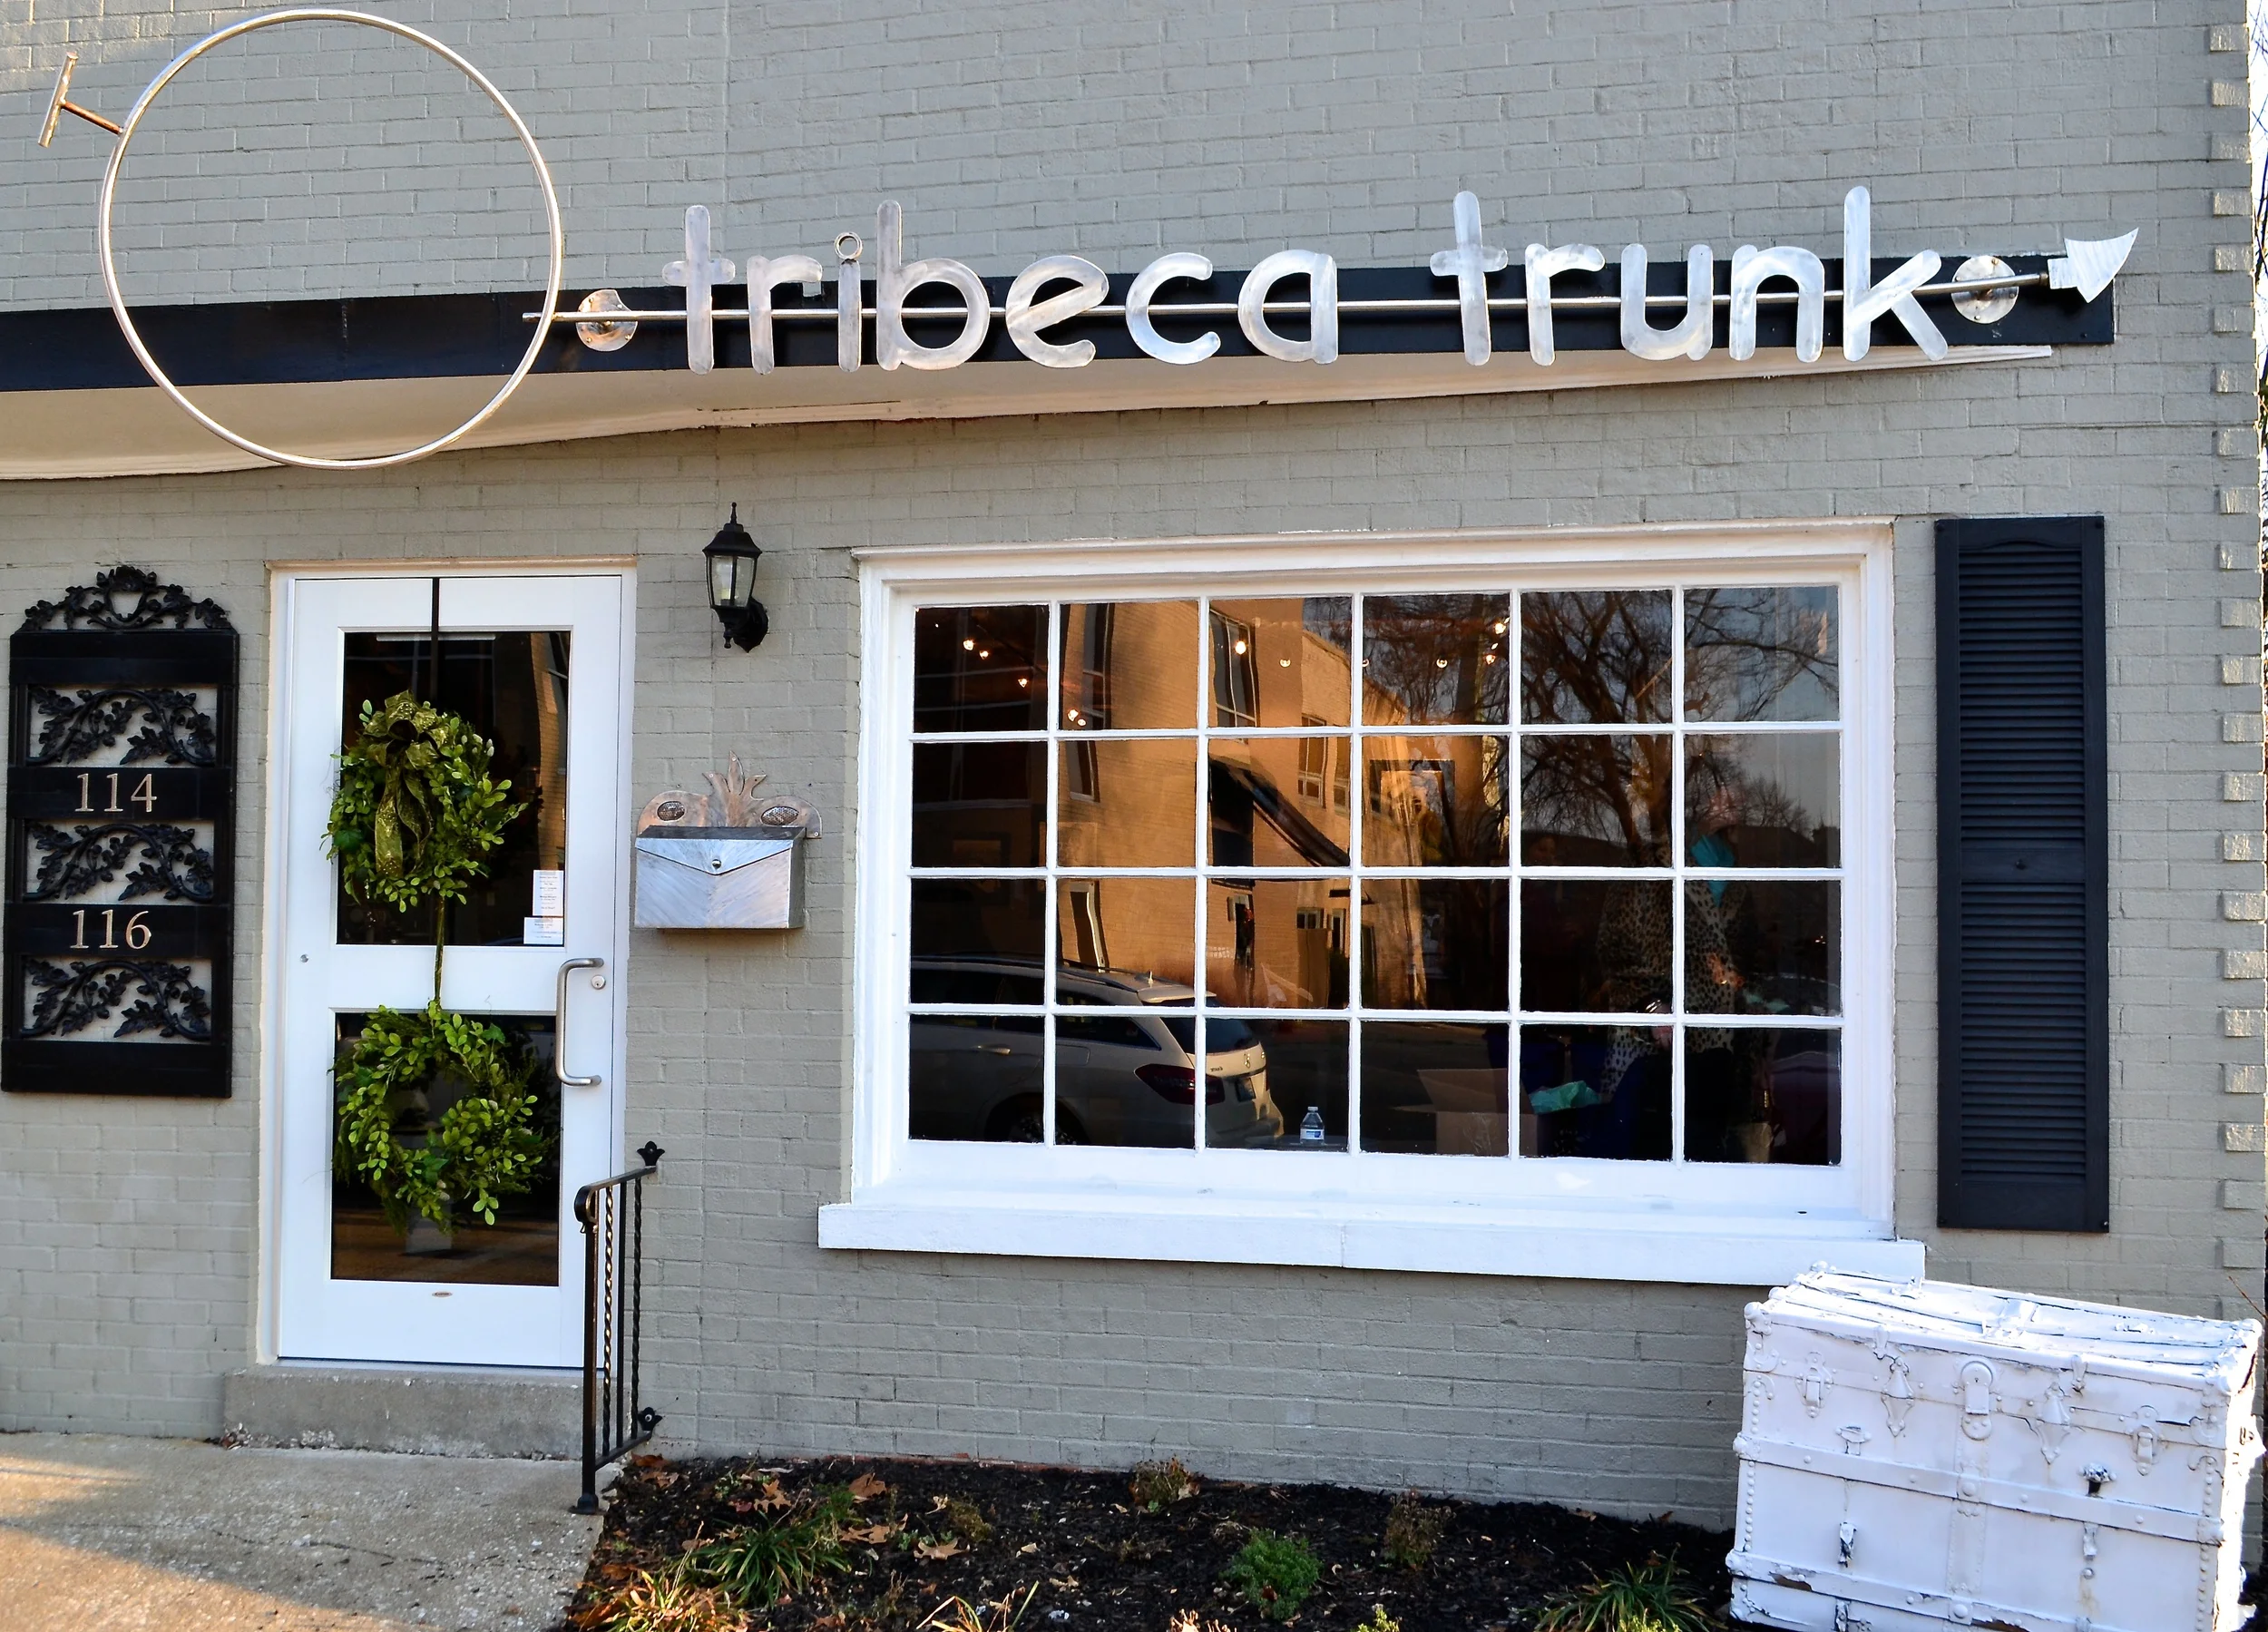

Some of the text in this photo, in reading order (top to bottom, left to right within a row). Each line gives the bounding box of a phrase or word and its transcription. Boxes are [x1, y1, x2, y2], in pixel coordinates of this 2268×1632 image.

[662, 185, 1949, 375] tribeca trunk
[74, 773, 157, 813] 114
[70, 909, 152, 949] 116
